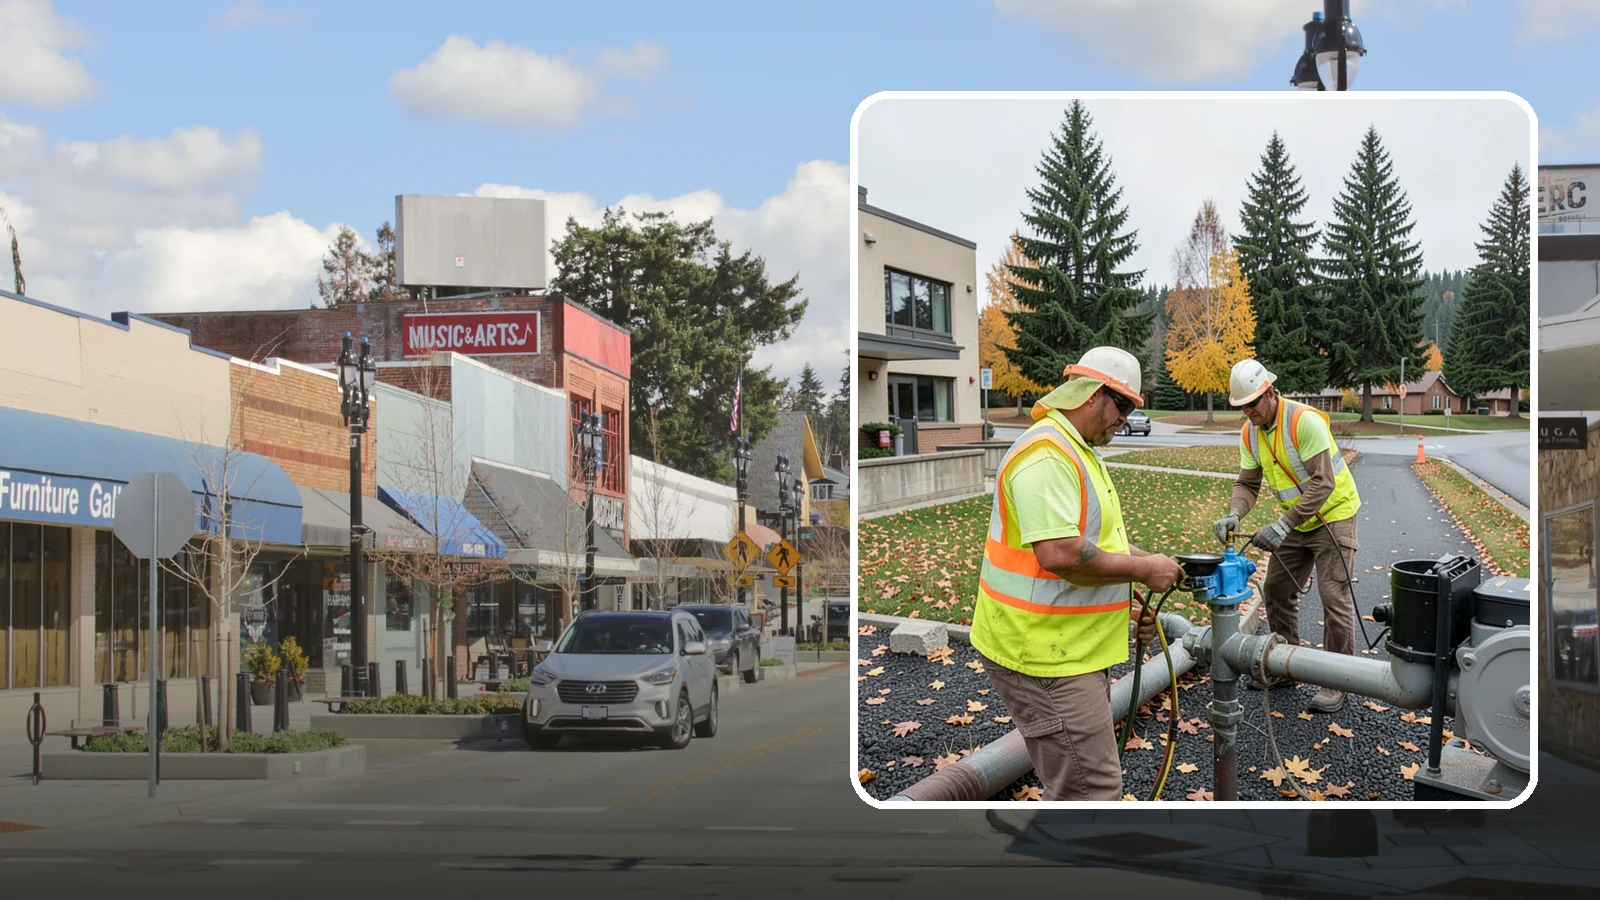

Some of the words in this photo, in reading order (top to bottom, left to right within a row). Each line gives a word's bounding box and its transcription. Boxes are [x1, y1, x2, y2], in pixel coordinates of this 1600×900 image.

[408, 323, 519, 348] MUSIC&ARTS
[0, 471, 79, 515] Furniture
[89, 482, 121, 519] Gal
